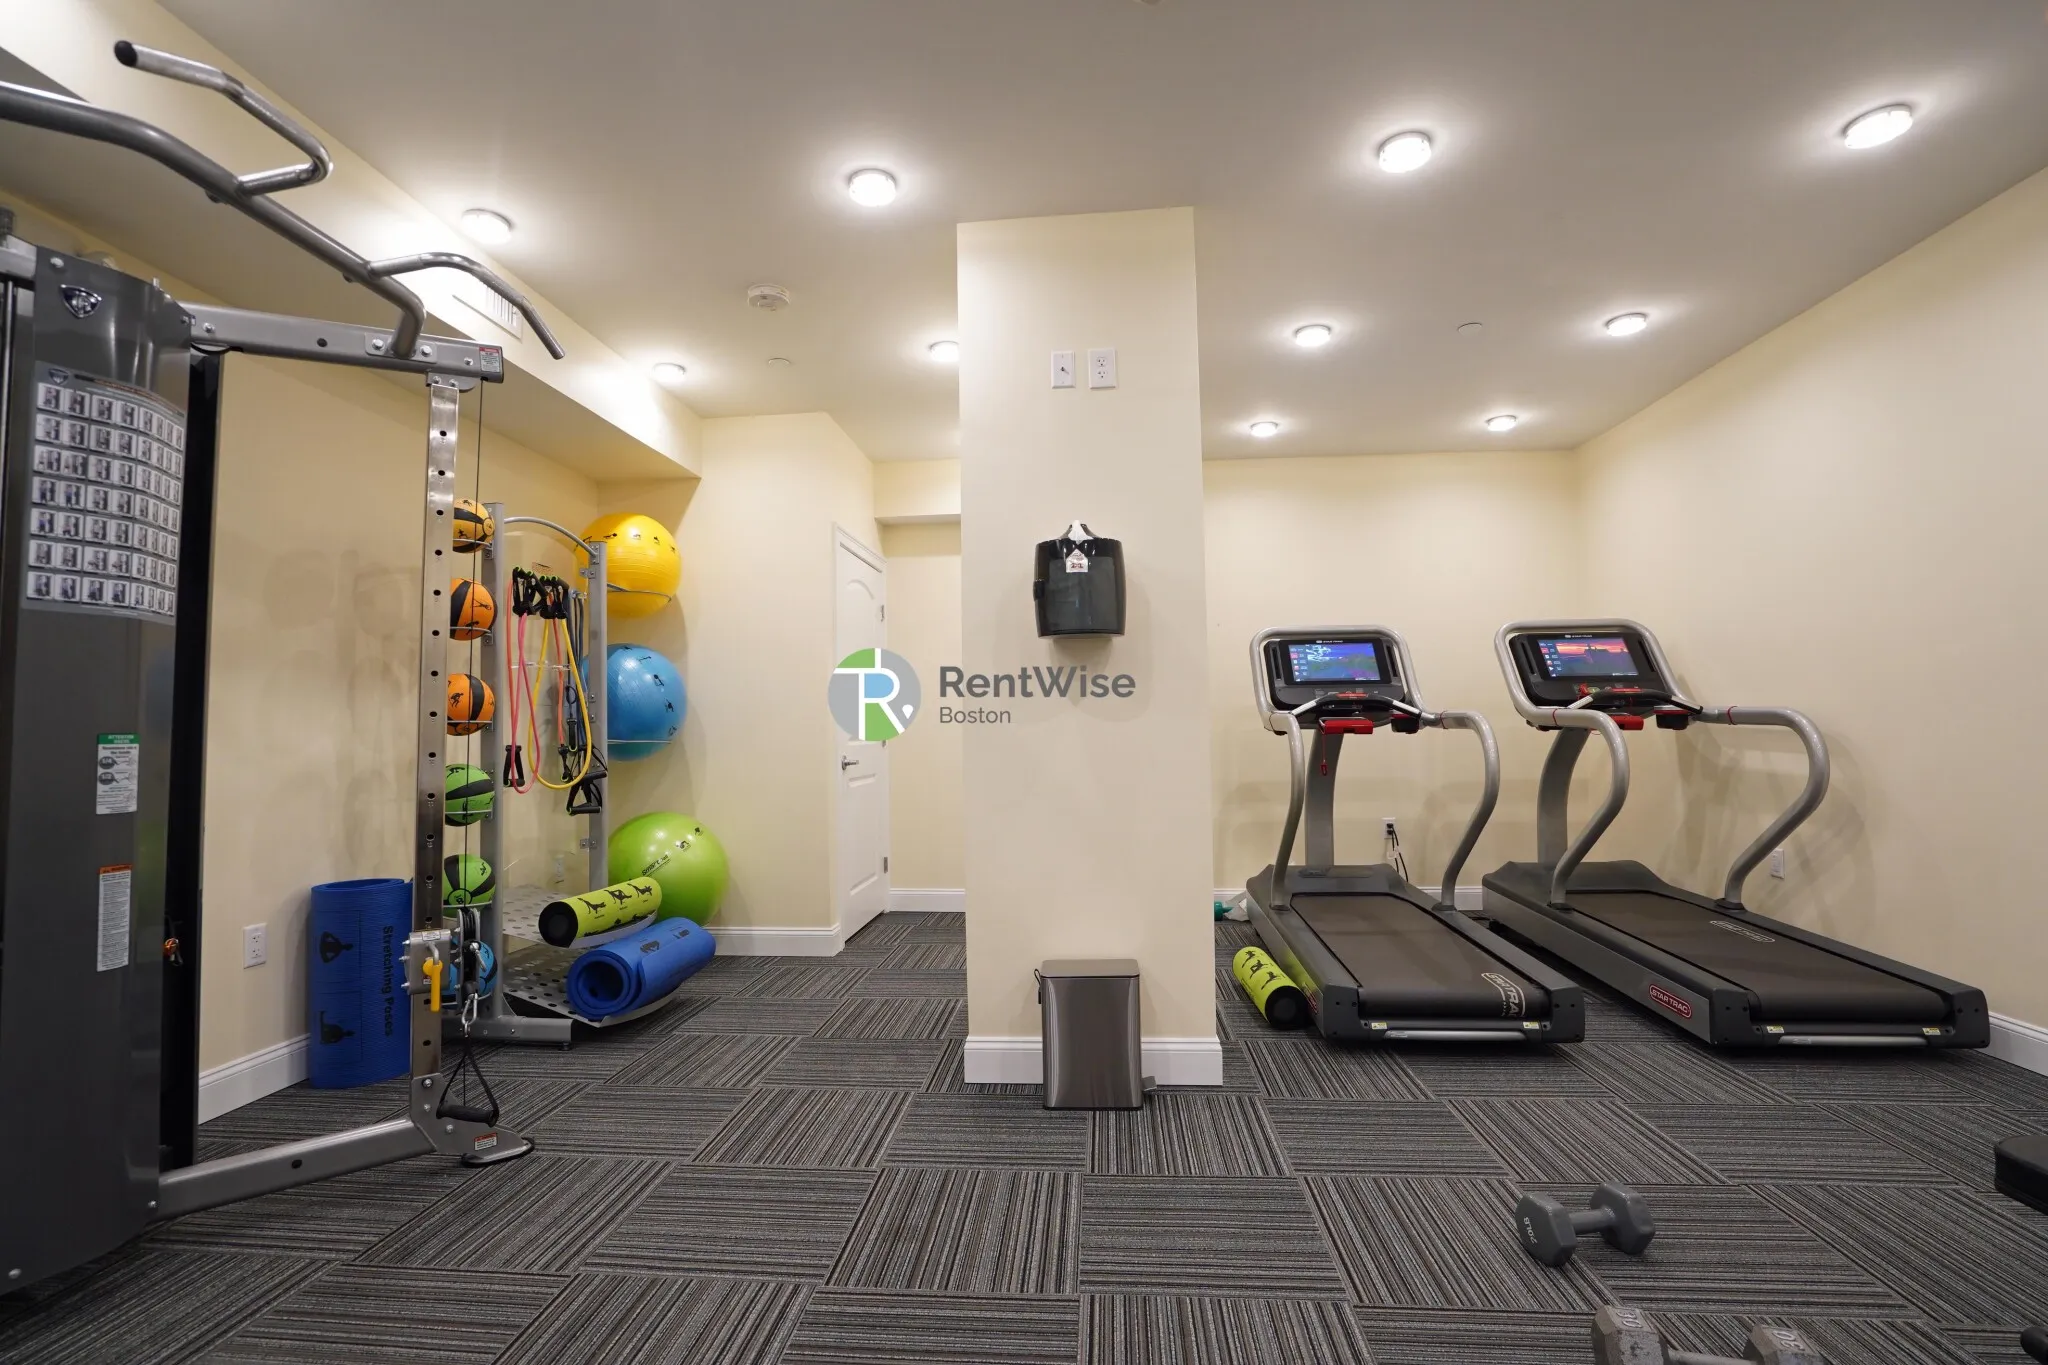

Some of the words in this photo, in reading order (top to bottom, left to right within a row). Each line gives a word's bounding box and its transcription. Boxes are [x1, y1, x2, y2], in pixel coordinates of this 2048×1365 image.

[381, 925, 394, 994] Stretching
[384, 996, 395, 1037] Poses
[1652, 989, 1669, 1003] STAR
[1667, 997, 1689, 1013] TRAC
